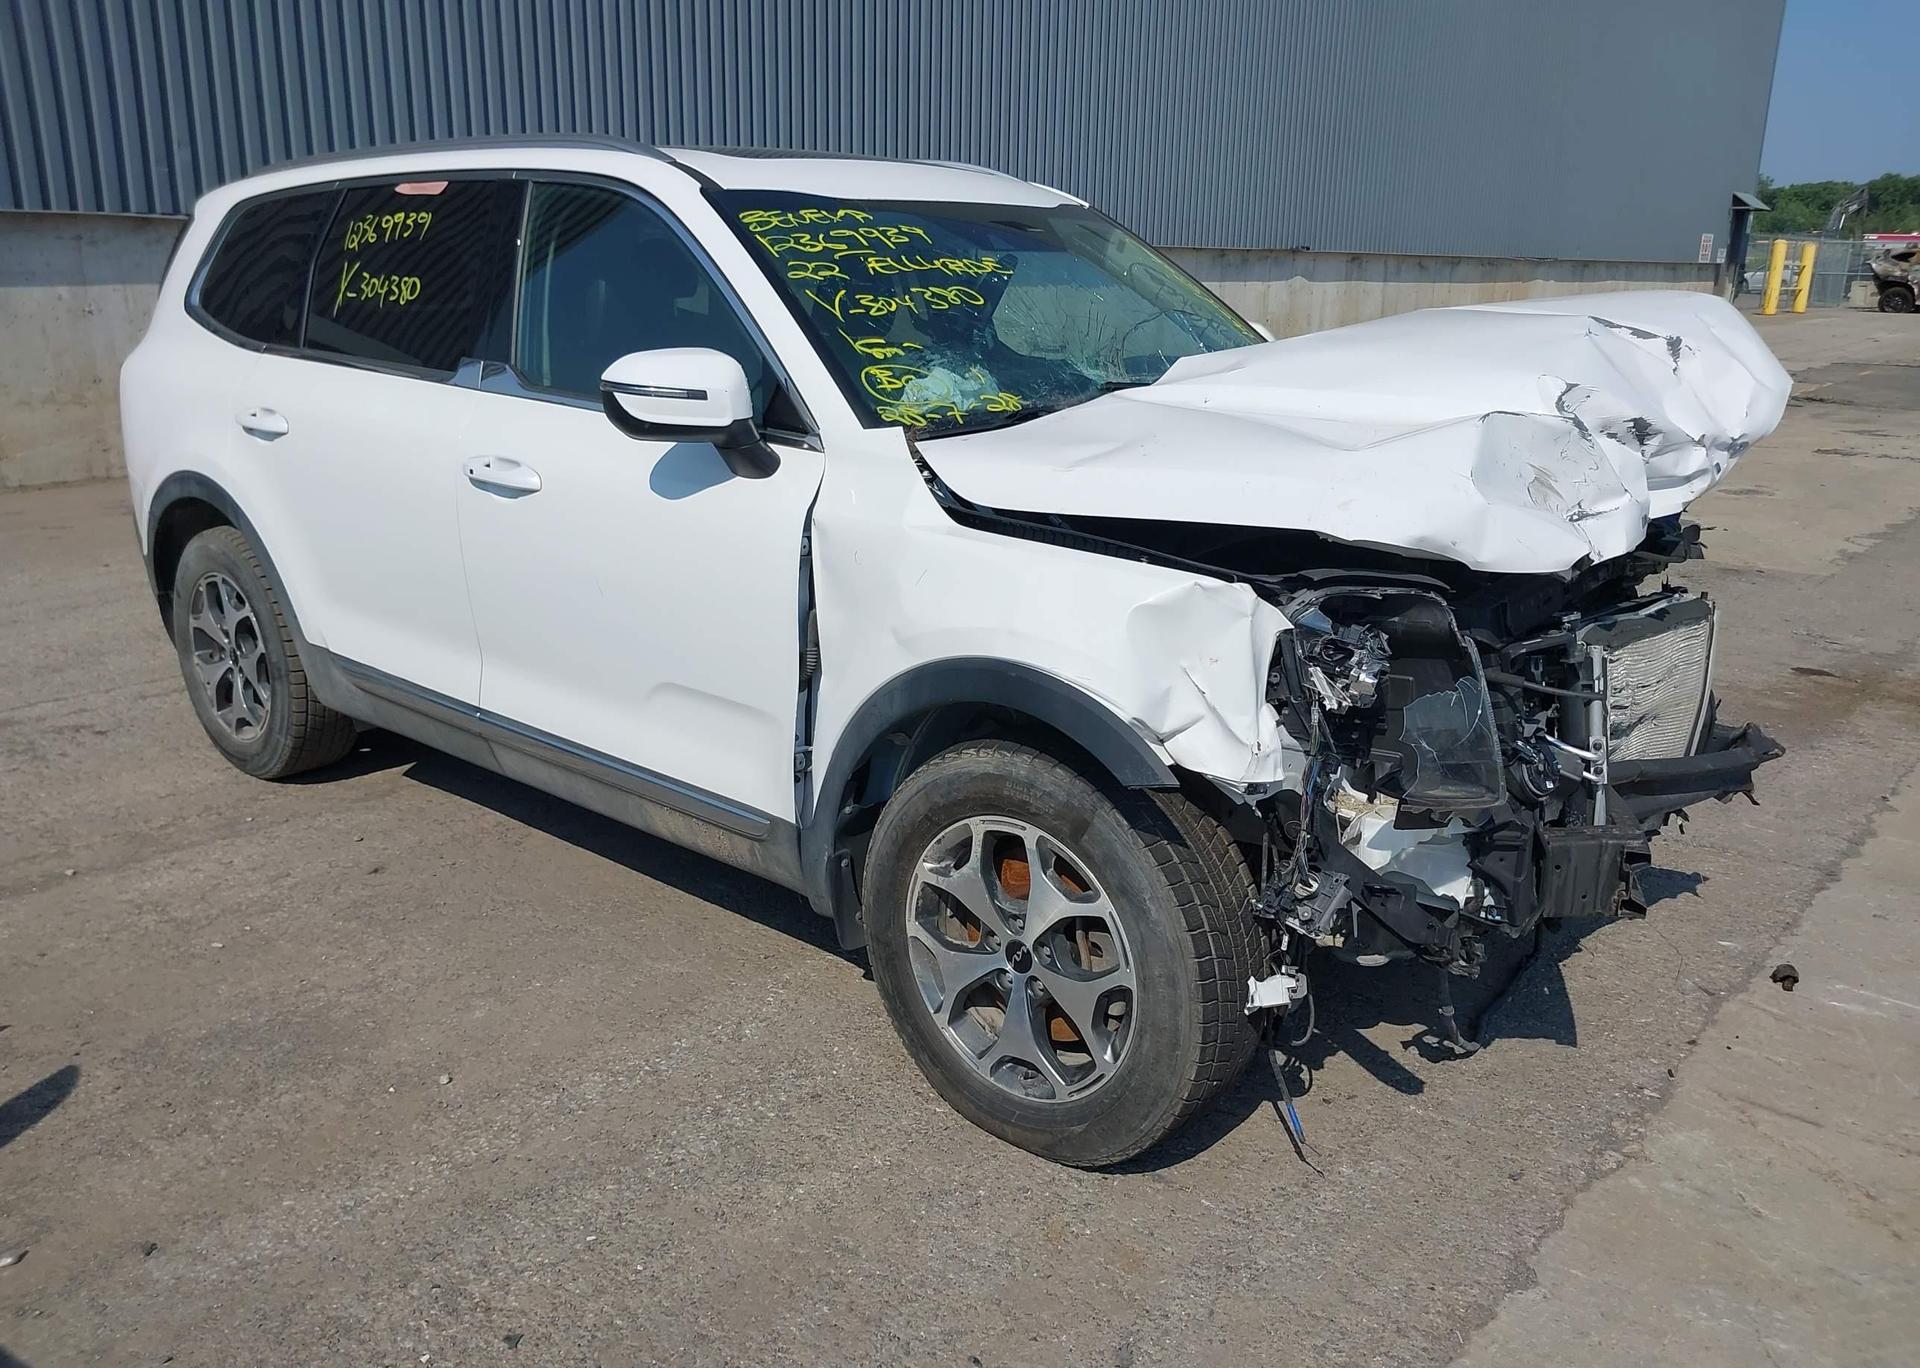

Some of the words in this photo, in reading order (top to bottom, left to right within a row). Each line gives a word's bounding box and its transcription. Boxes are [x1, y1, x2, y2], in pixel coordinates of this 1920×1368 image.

[345, 211, 433, 251] 12369939
[756, 225, 932, 257] 12369939
[787, 261, 850, 280] 22
